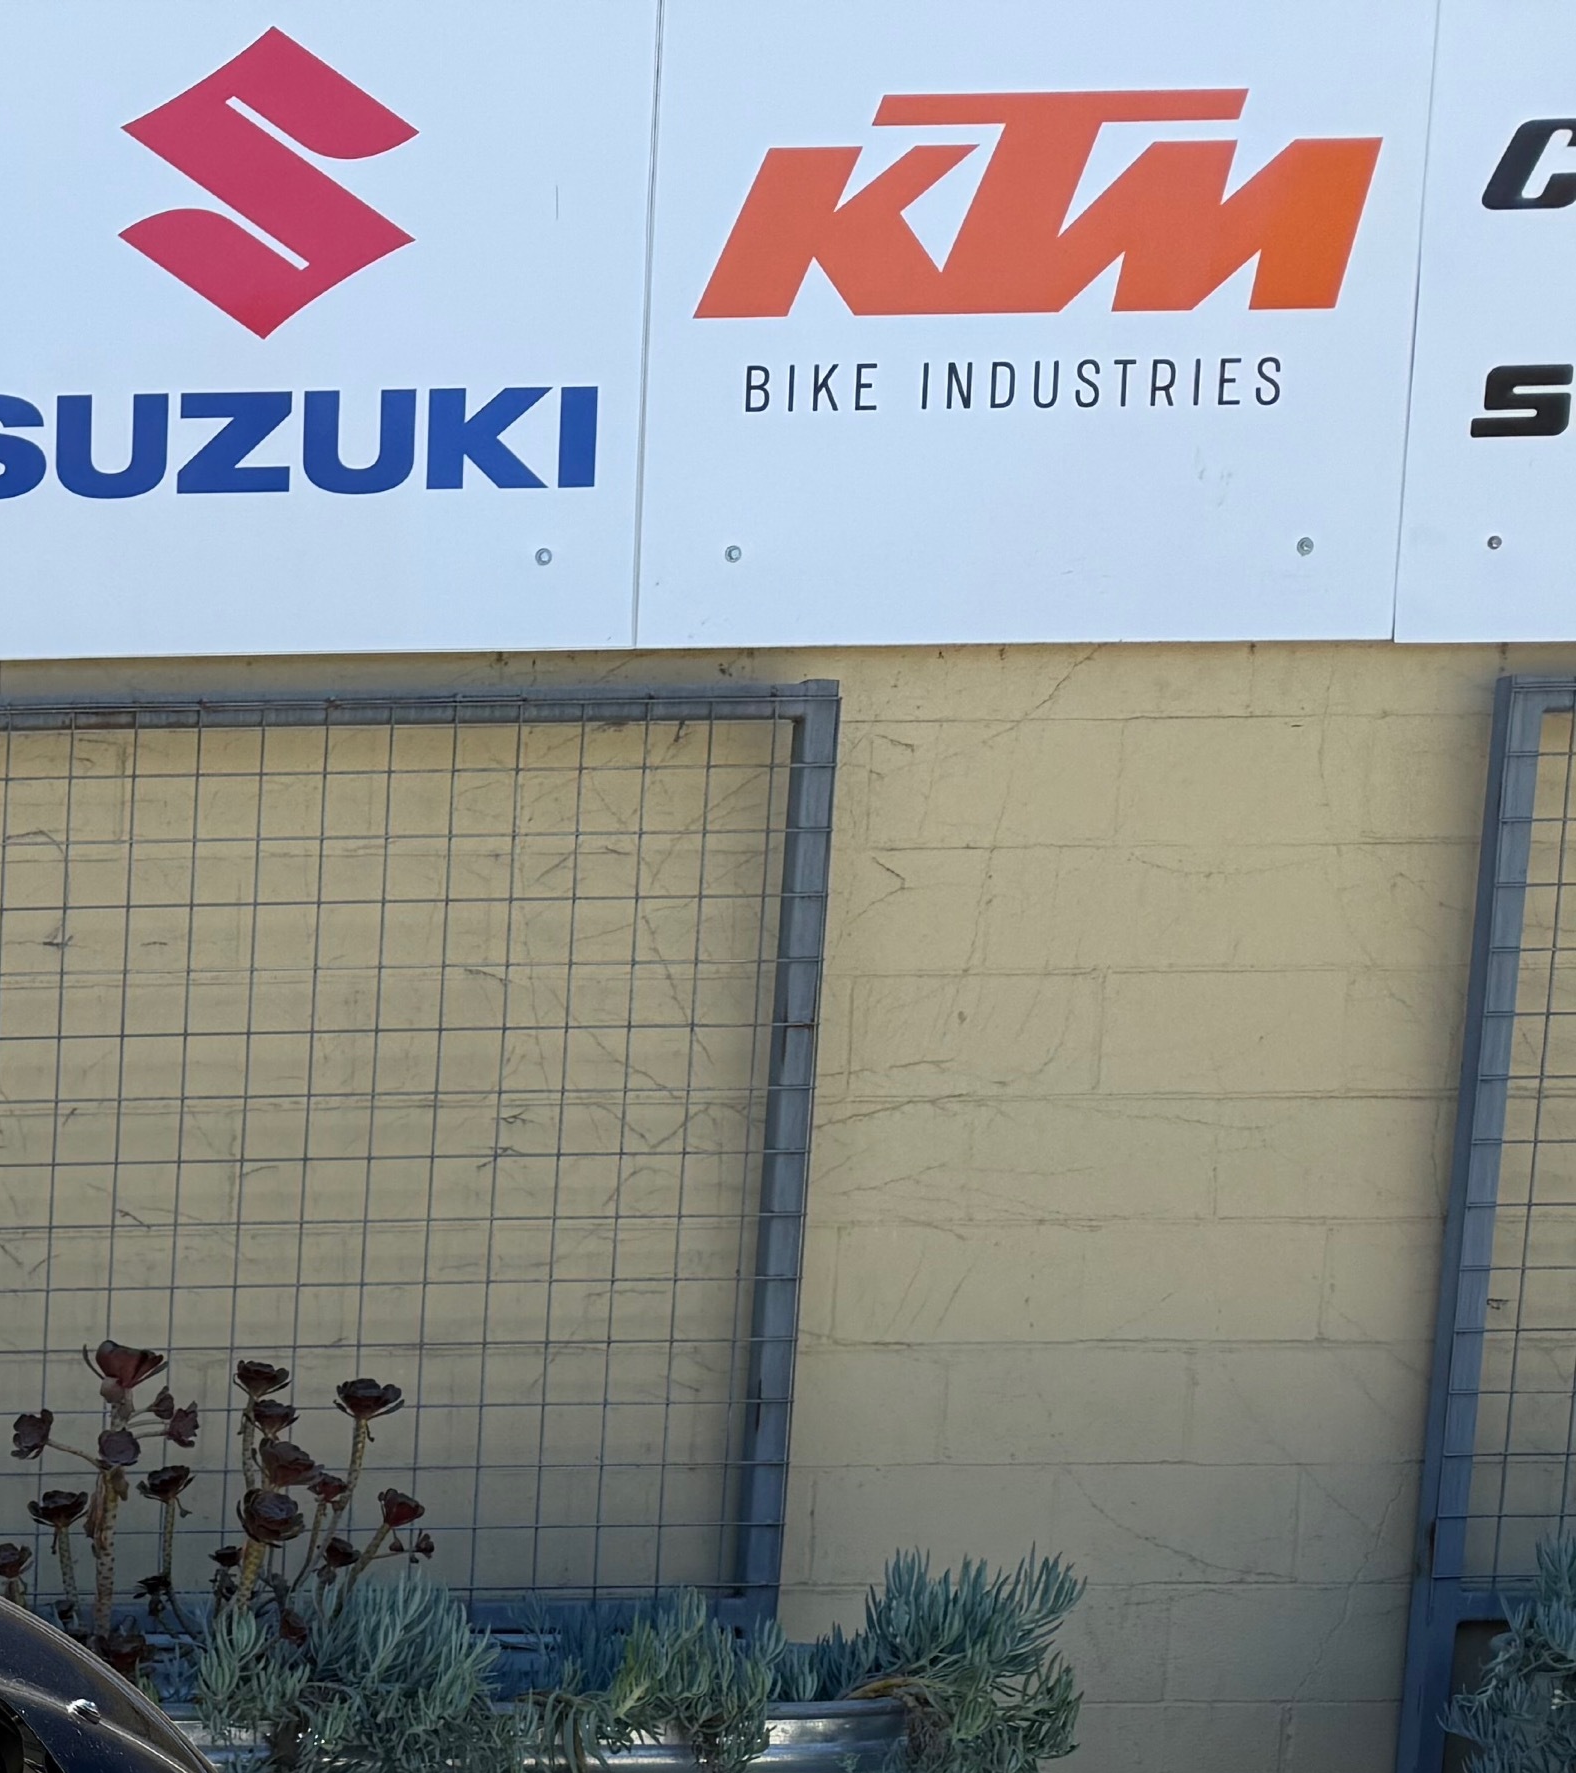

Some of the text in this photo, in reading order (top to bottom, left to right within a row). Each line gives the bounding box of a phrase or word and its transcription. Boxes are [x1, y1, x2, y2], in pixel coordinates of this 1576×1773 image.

[694, 88, 1384, 320] KTM
[744, 356, 1283, 413] BIKE INDUSTRIES
